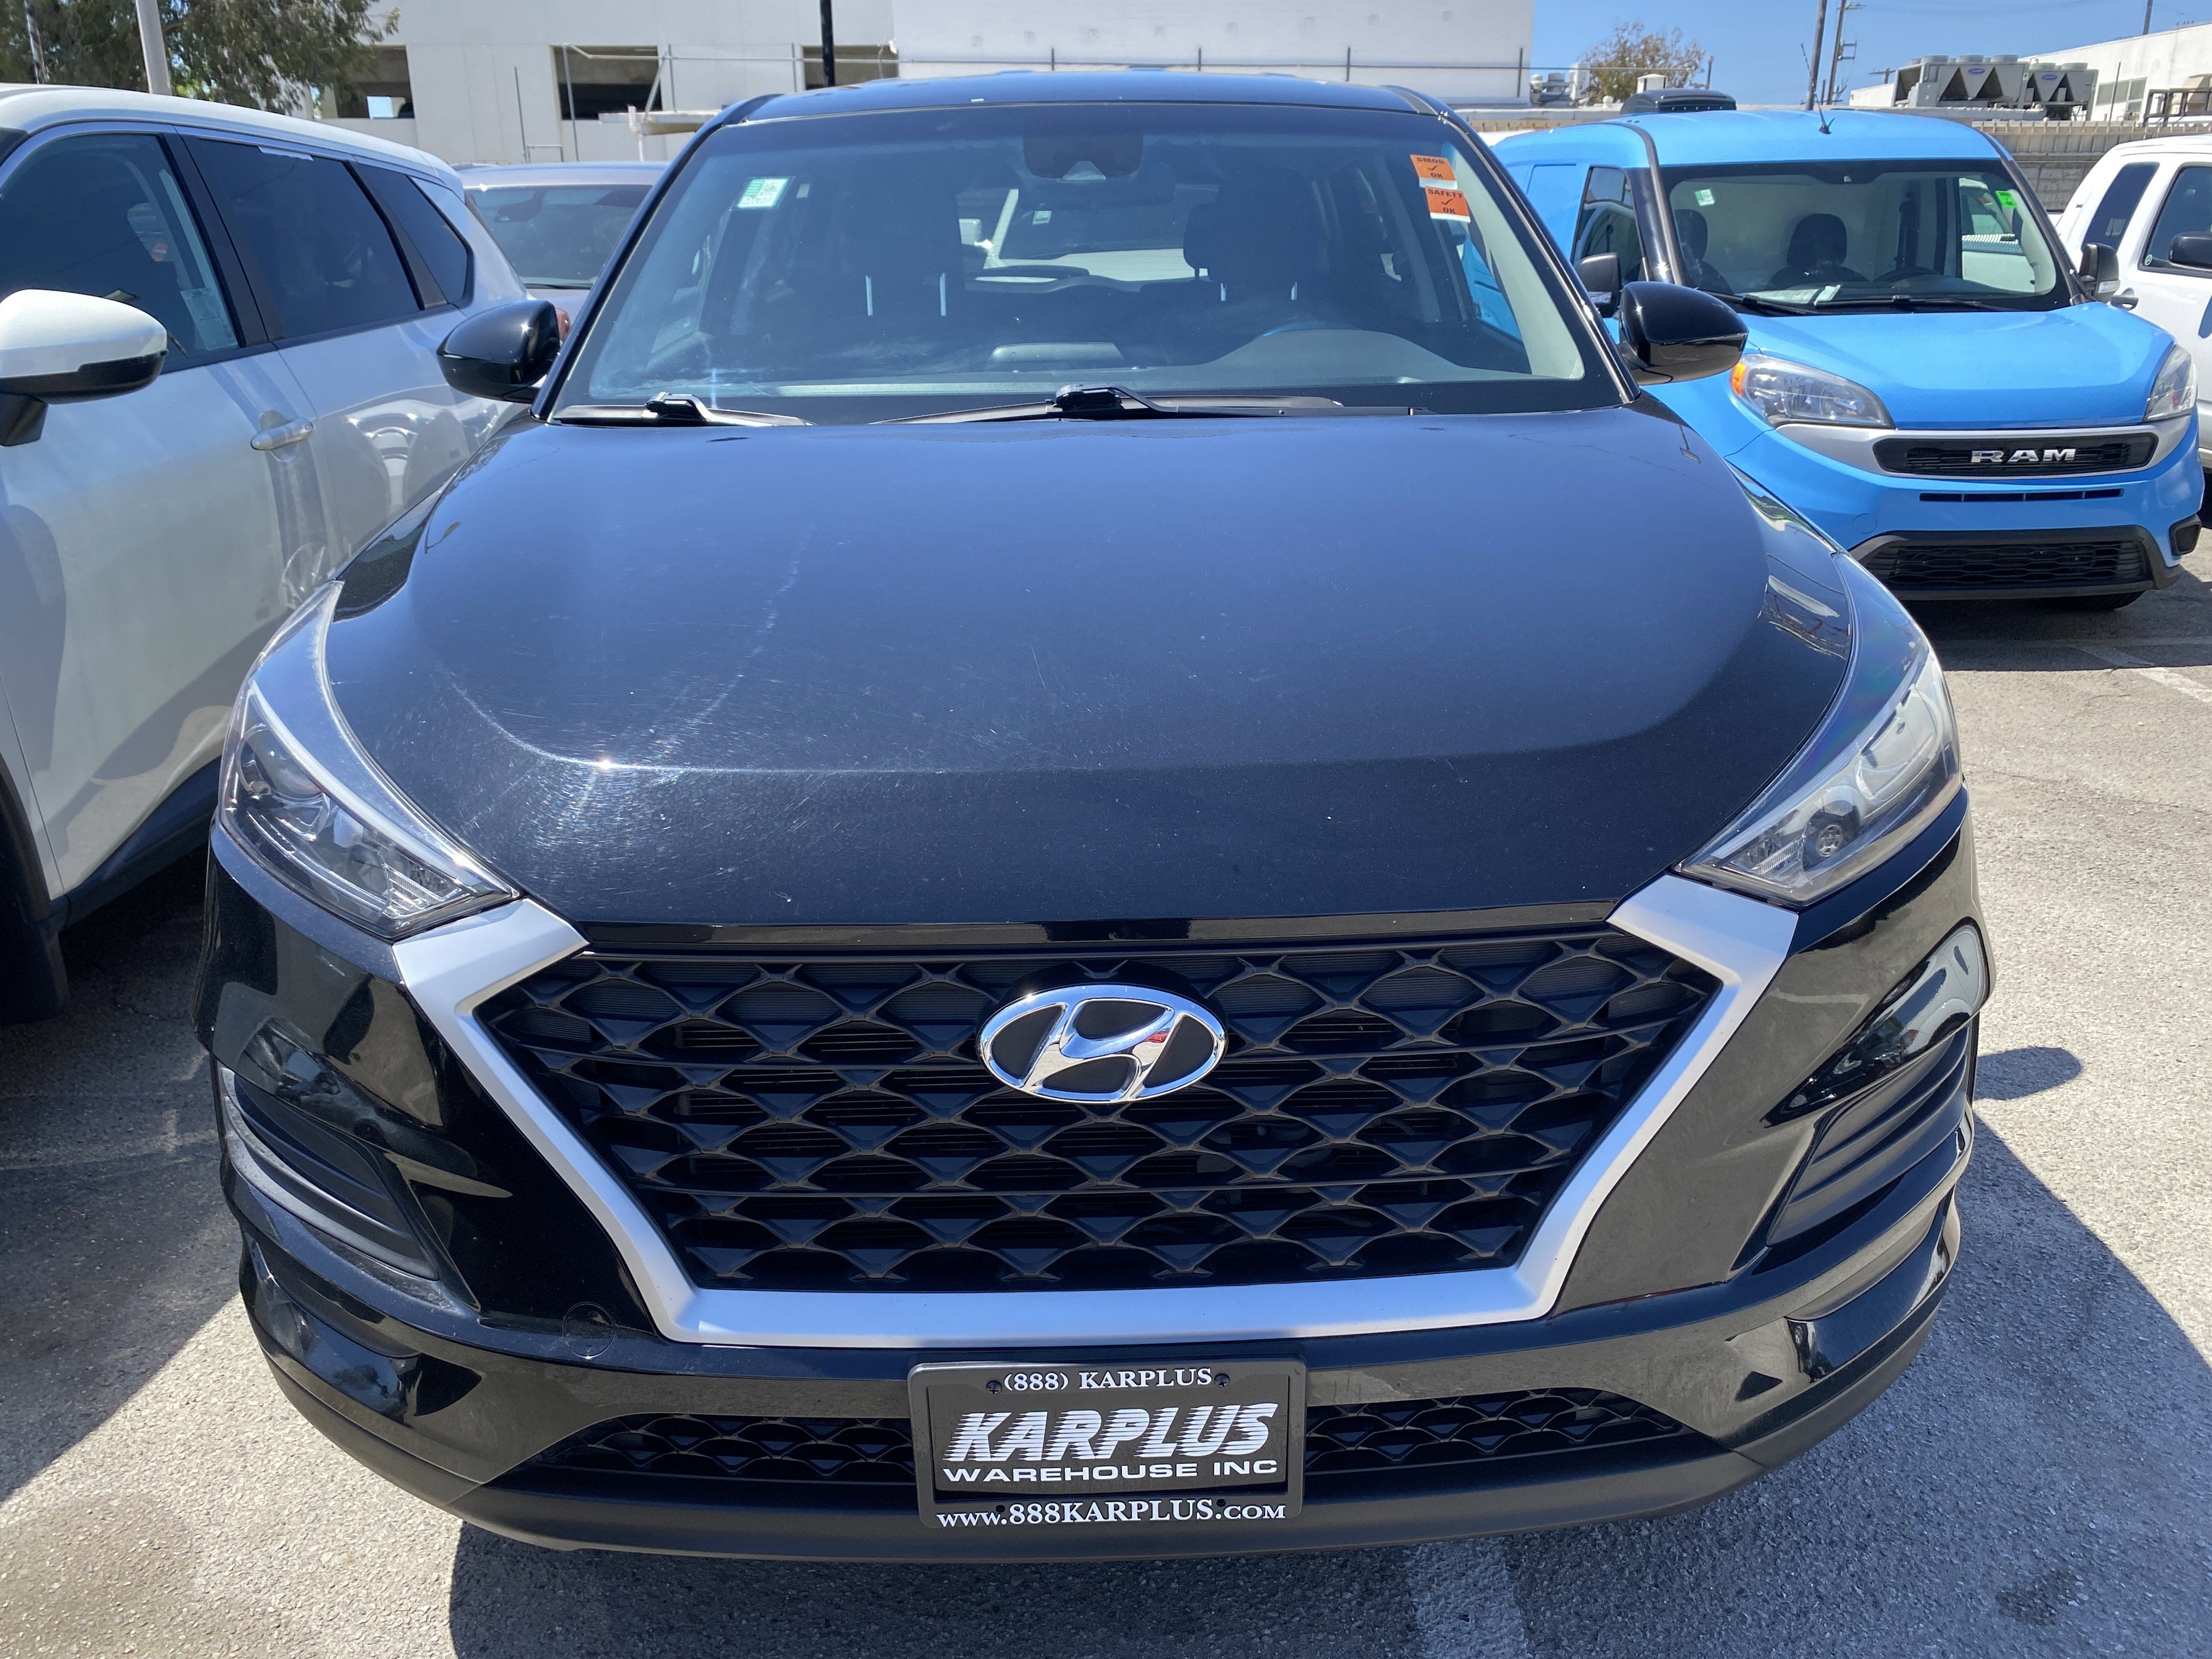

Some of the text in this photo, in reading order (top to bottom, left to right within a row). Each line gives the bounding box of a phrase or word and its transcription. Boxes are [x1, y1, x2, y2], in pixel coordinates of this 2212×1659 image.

[1427, 188, 1463, 198] SAFETY
[1971, 448, 2076, 463] RAM
[1004, 1368, 1212, 1391] (888) KARPLUS
[943, 1403, 1279, 1462] KARPLUS
[943, 1460, 1278, 1482] WAREHOUSE INC
